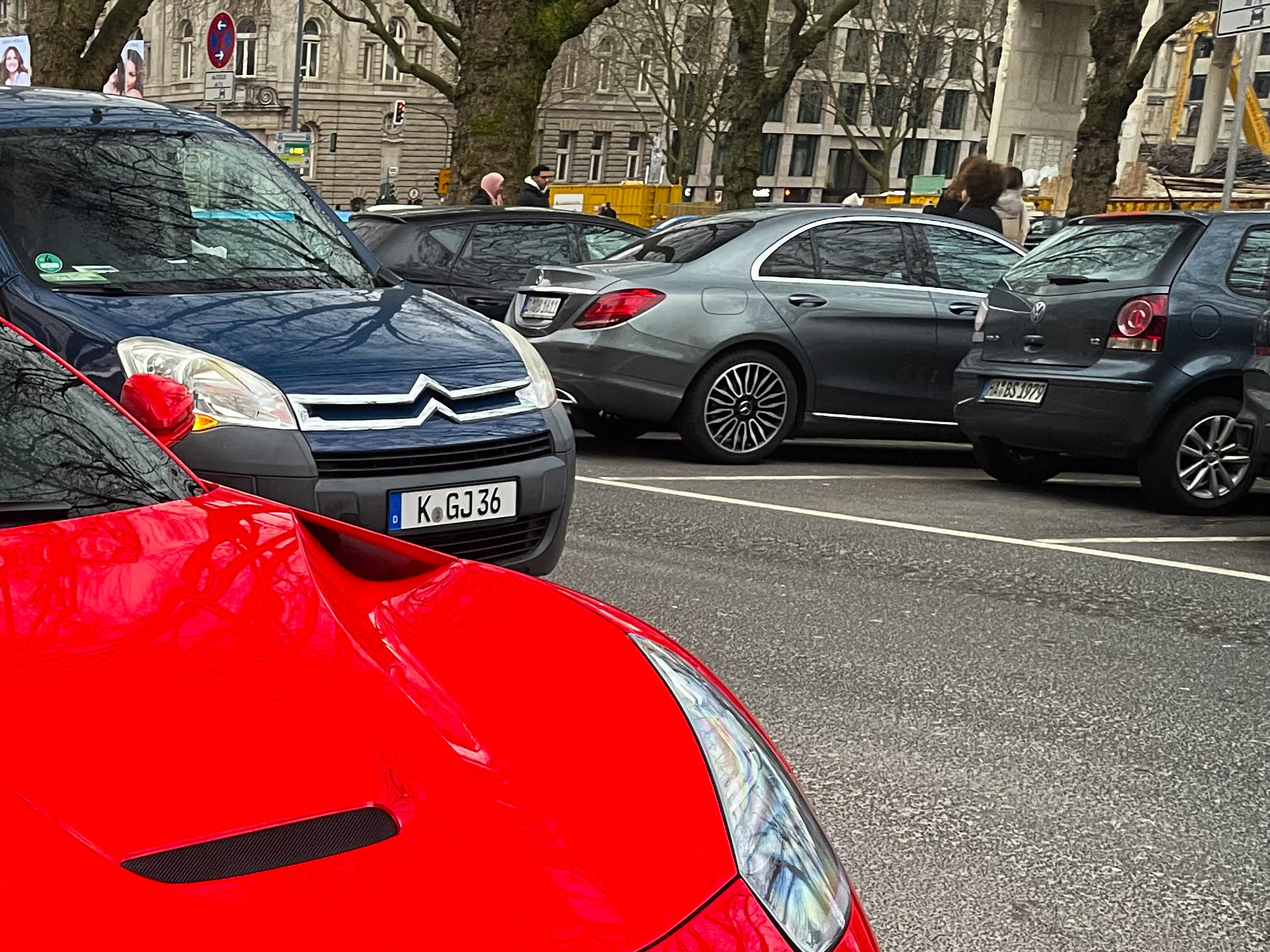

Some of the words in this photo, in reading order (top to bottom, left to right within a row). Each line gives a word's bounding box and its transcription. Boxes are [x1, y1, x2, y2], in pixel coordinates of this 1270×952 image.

[1017, 382, 1046, 401] 1979
[417, 494, 432, 523] K
[392, 515, 399, 524] D
